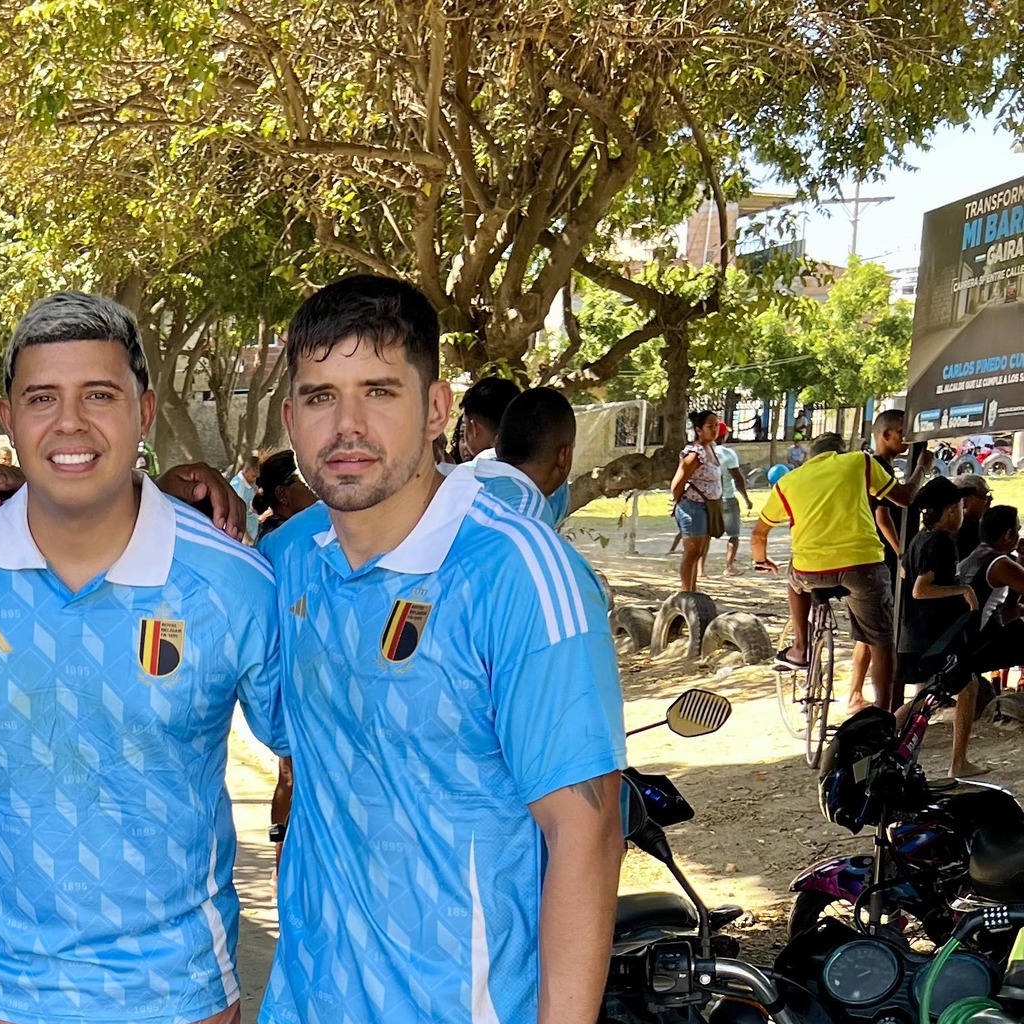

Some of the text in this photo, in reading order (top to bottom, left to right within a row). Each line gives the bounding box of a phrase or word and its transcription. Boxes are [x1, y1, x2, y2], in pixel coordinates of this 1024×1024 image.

[962, 217, 984, 250] MI
[943, 361, 975, 380] CARLOS
[64, 663, 91, 677] 1895
